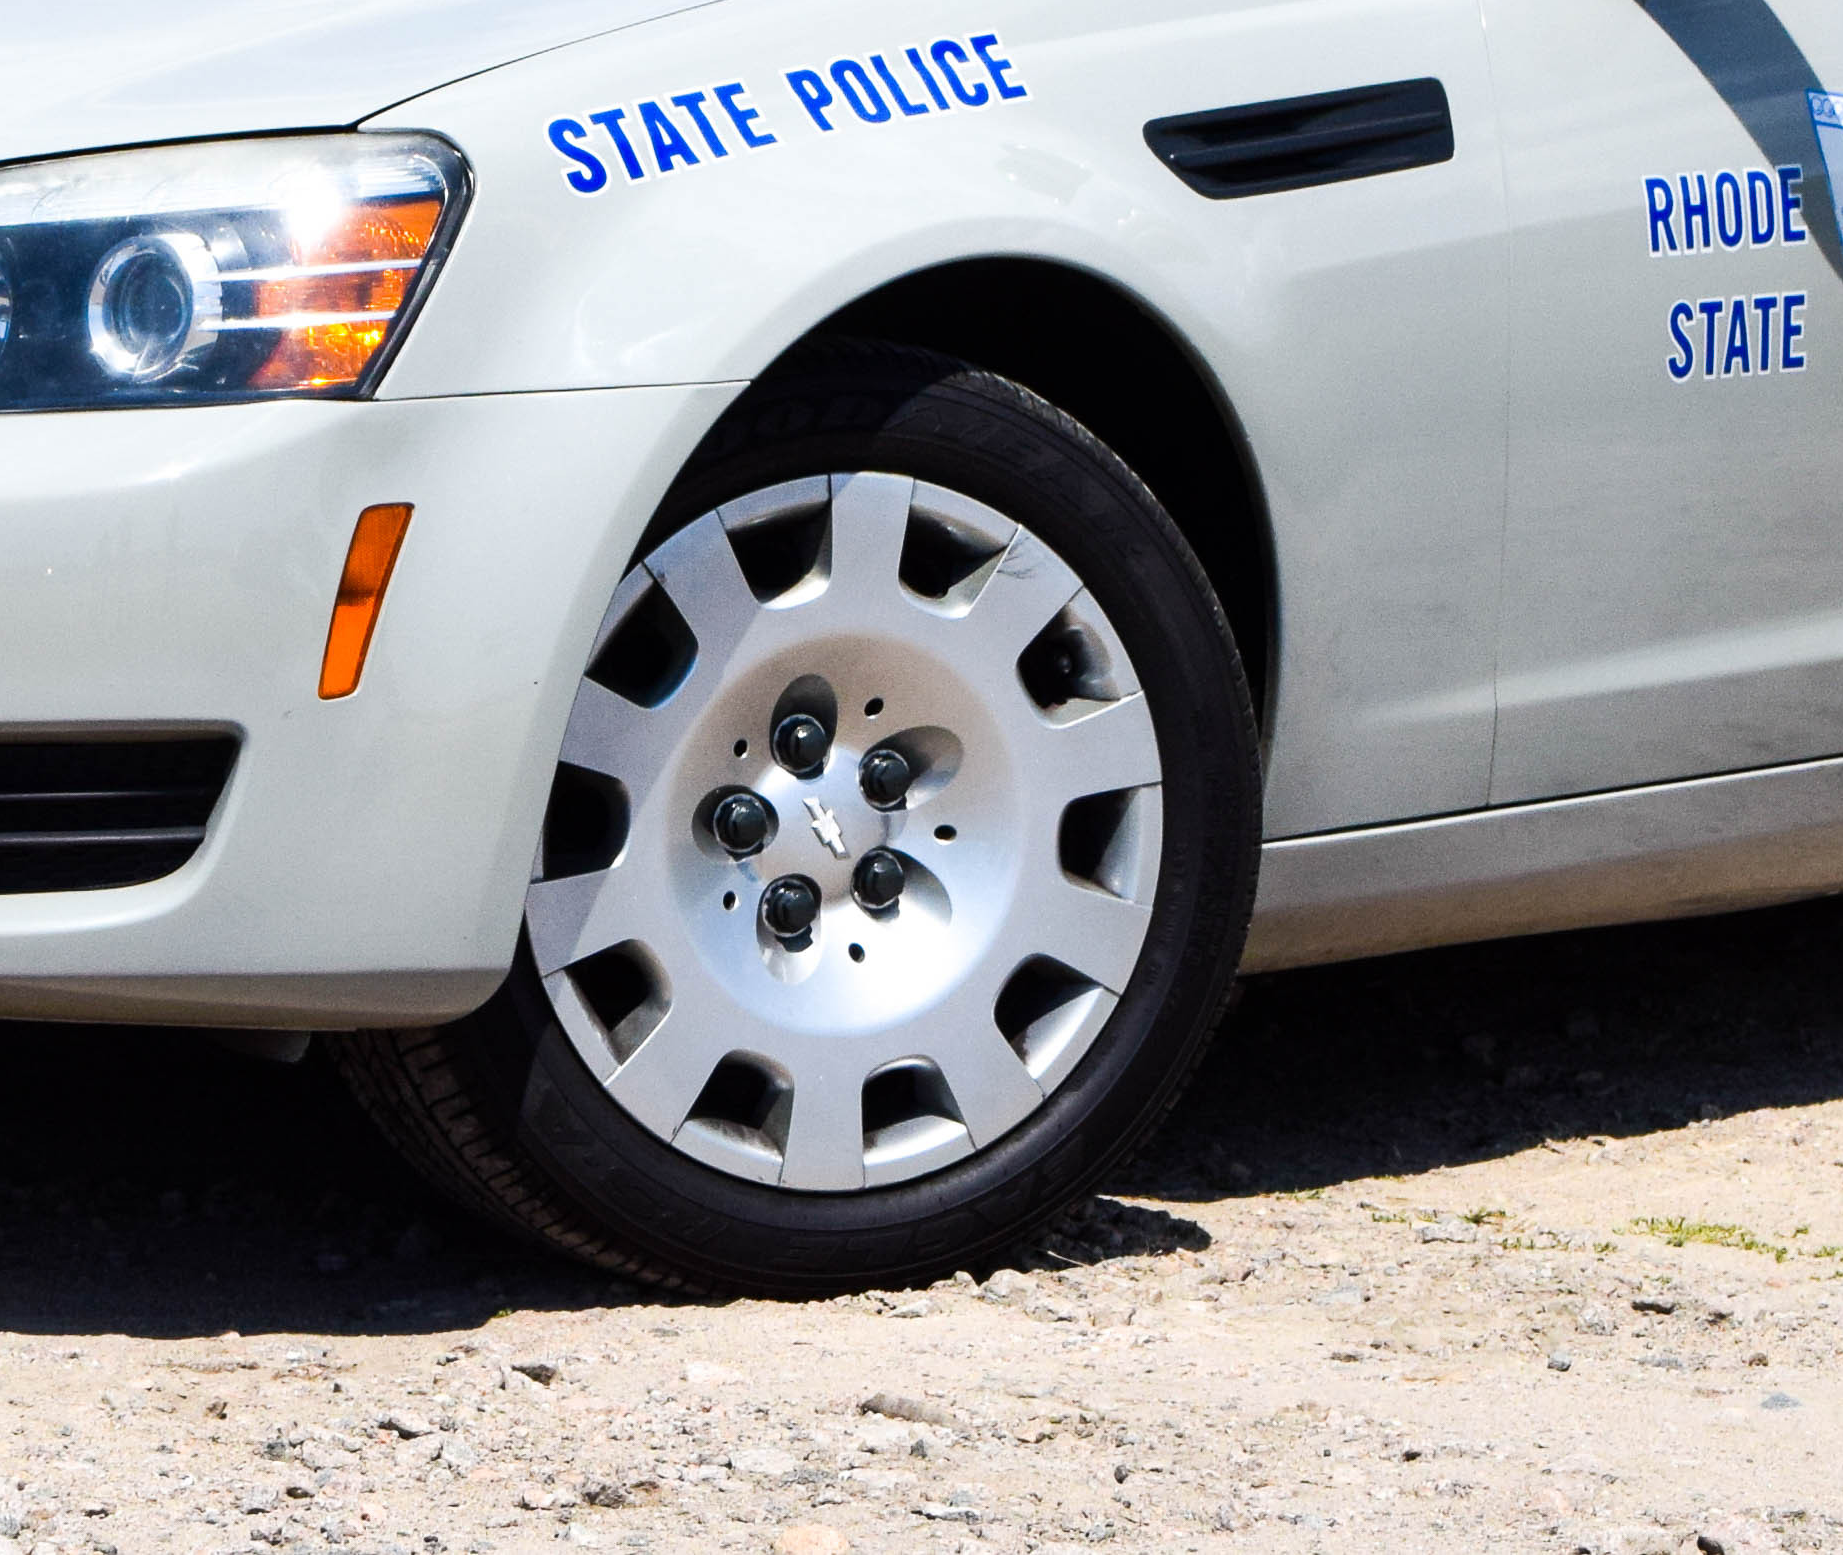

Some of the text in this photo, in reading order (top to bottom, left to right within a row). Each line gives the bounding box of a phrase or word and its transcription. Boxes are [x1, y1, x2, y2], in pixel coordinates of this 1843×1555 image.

[547, 33, 1028, 194] STATE POLICE
[1644, 166, 1807, 253] RHODE
[1668, 293, 1806, 380] STATE
